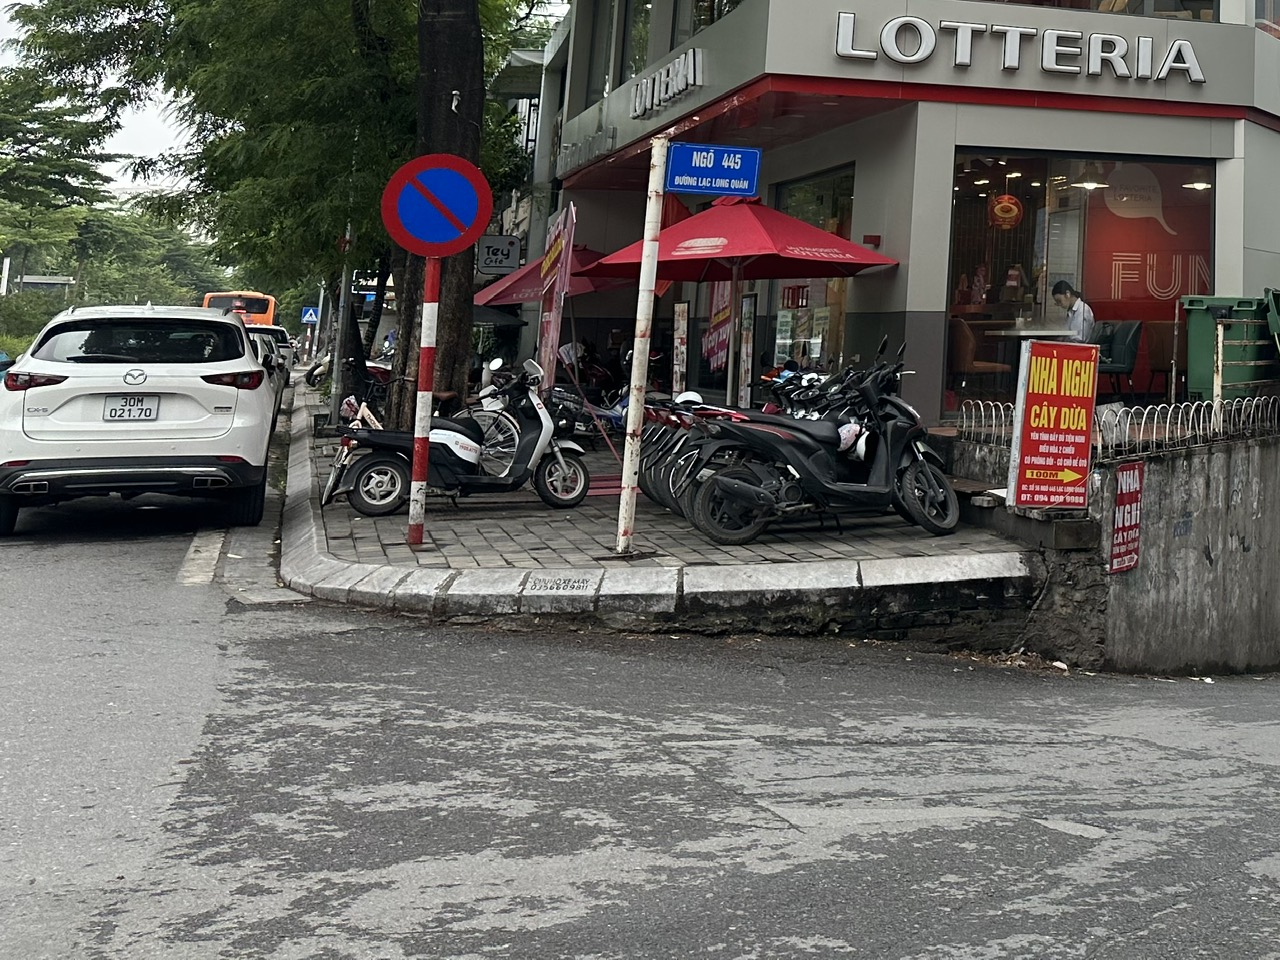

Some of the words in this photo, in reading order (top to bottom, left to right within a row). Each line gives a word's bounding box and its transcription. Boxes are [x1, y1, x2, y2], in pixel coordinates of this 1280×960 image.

[835, 11, 1207, 84] LOTTERIA
[692, 149, 714, 168] NGÕ
[722, 154, 741, 170] 445
[674, 175, 698, 187] ĐƯỜNG
[699, 177, 711, 189] LẠC
[712, 178, 729, 188] LONG
[730, 178, 749, 190] QUÂN
[485, 245, 510, 259] Tey
[1029, 350, 1057, 395] NHÀ
[1061, 349, 1095, 398] NGHỈ
[121, 398, 144, 407] 30M
[110, 408, 152, 419] 021.70
[1030, 402, 1058, 429] CÂY
[1060, 402, 1087, 431] DỪA
[1030, 471, 1059, 479] 100M
[1118, 464, 1140, 495] NHÀ
[1115, 494, 1141, 529] NGHỈ
